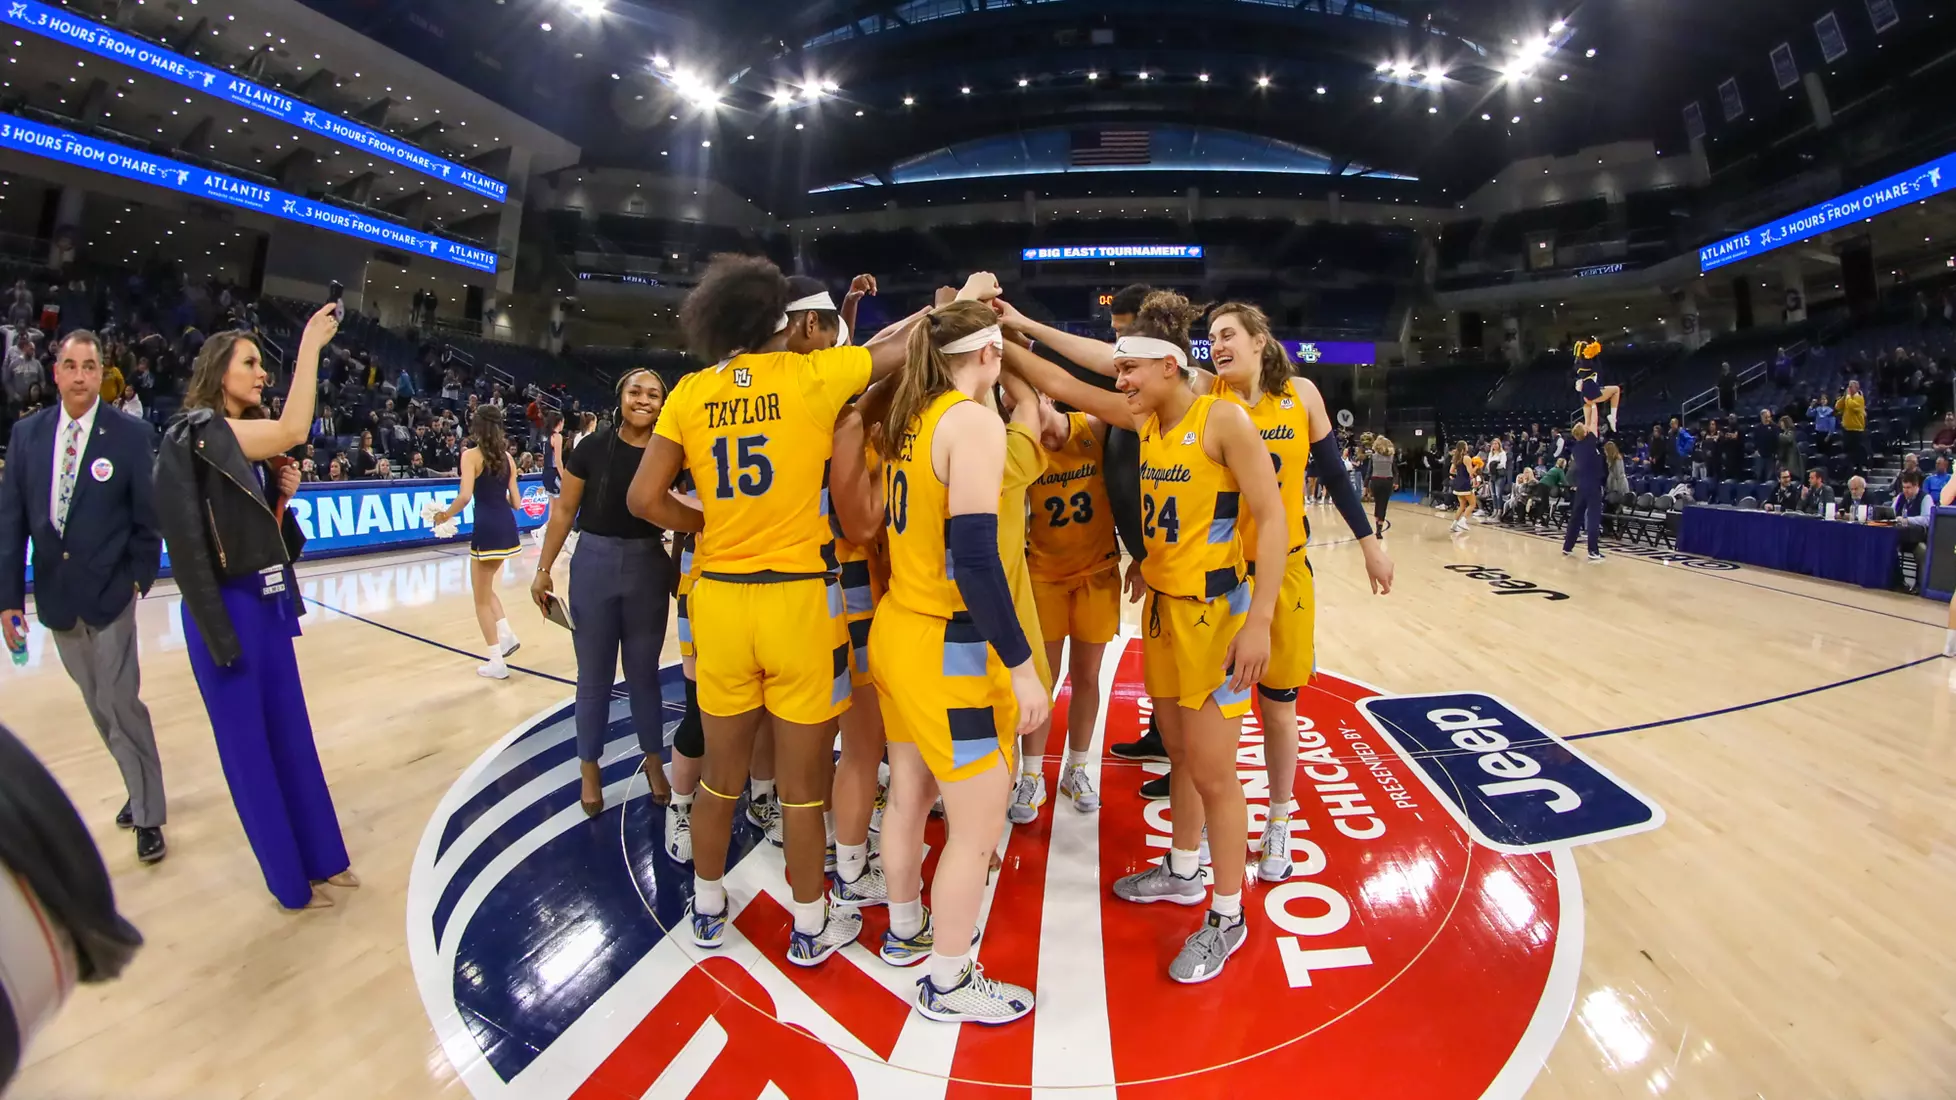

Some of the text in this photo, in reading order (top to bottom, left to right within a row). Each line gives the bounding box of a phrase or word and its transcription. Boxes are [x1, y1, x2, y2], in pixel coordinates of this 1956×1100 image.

[37, 13, 185, 76] 3 HOURS FROM O'HARE
[228, 80, 293, 112] ATLANTIS
[1, 124, 157, 176] 3 HOURS FROM O'HARE
[324, 120, 430, 169] 3 HOURS FROM O'HARE
[204, 175, 271, 202] ATLANTIS
[460, 170, 505, 195] ATLANTIS
[305, 206, 416, 246] 3 HOURS FROM O'HARE
[1780, 181, 1909, 237] 3 HOURS FROM O'HARE
[449, 244, 494, 265] ATLANTIS
[1038, 246, 1187, 258] BIG EAST TOURNAMENT
[1701, 235, 1751, 261] ATLANTIS
[1191, 346, 1209, 360] 03
[704, 392, 782, 429] TAYLOR
[711, 432, 775, 500] 15
[1044, 490, 1094, 528] 23
[1142, 493, 1180, 544] 24
[1443, 564, 1570, 601] Jeep
[1296, 715, 1387, 840] CHICAGO
[1338, 727, 1418, 809] PRESENTED BY
[1426, 707, 1582, 814] Jeep
